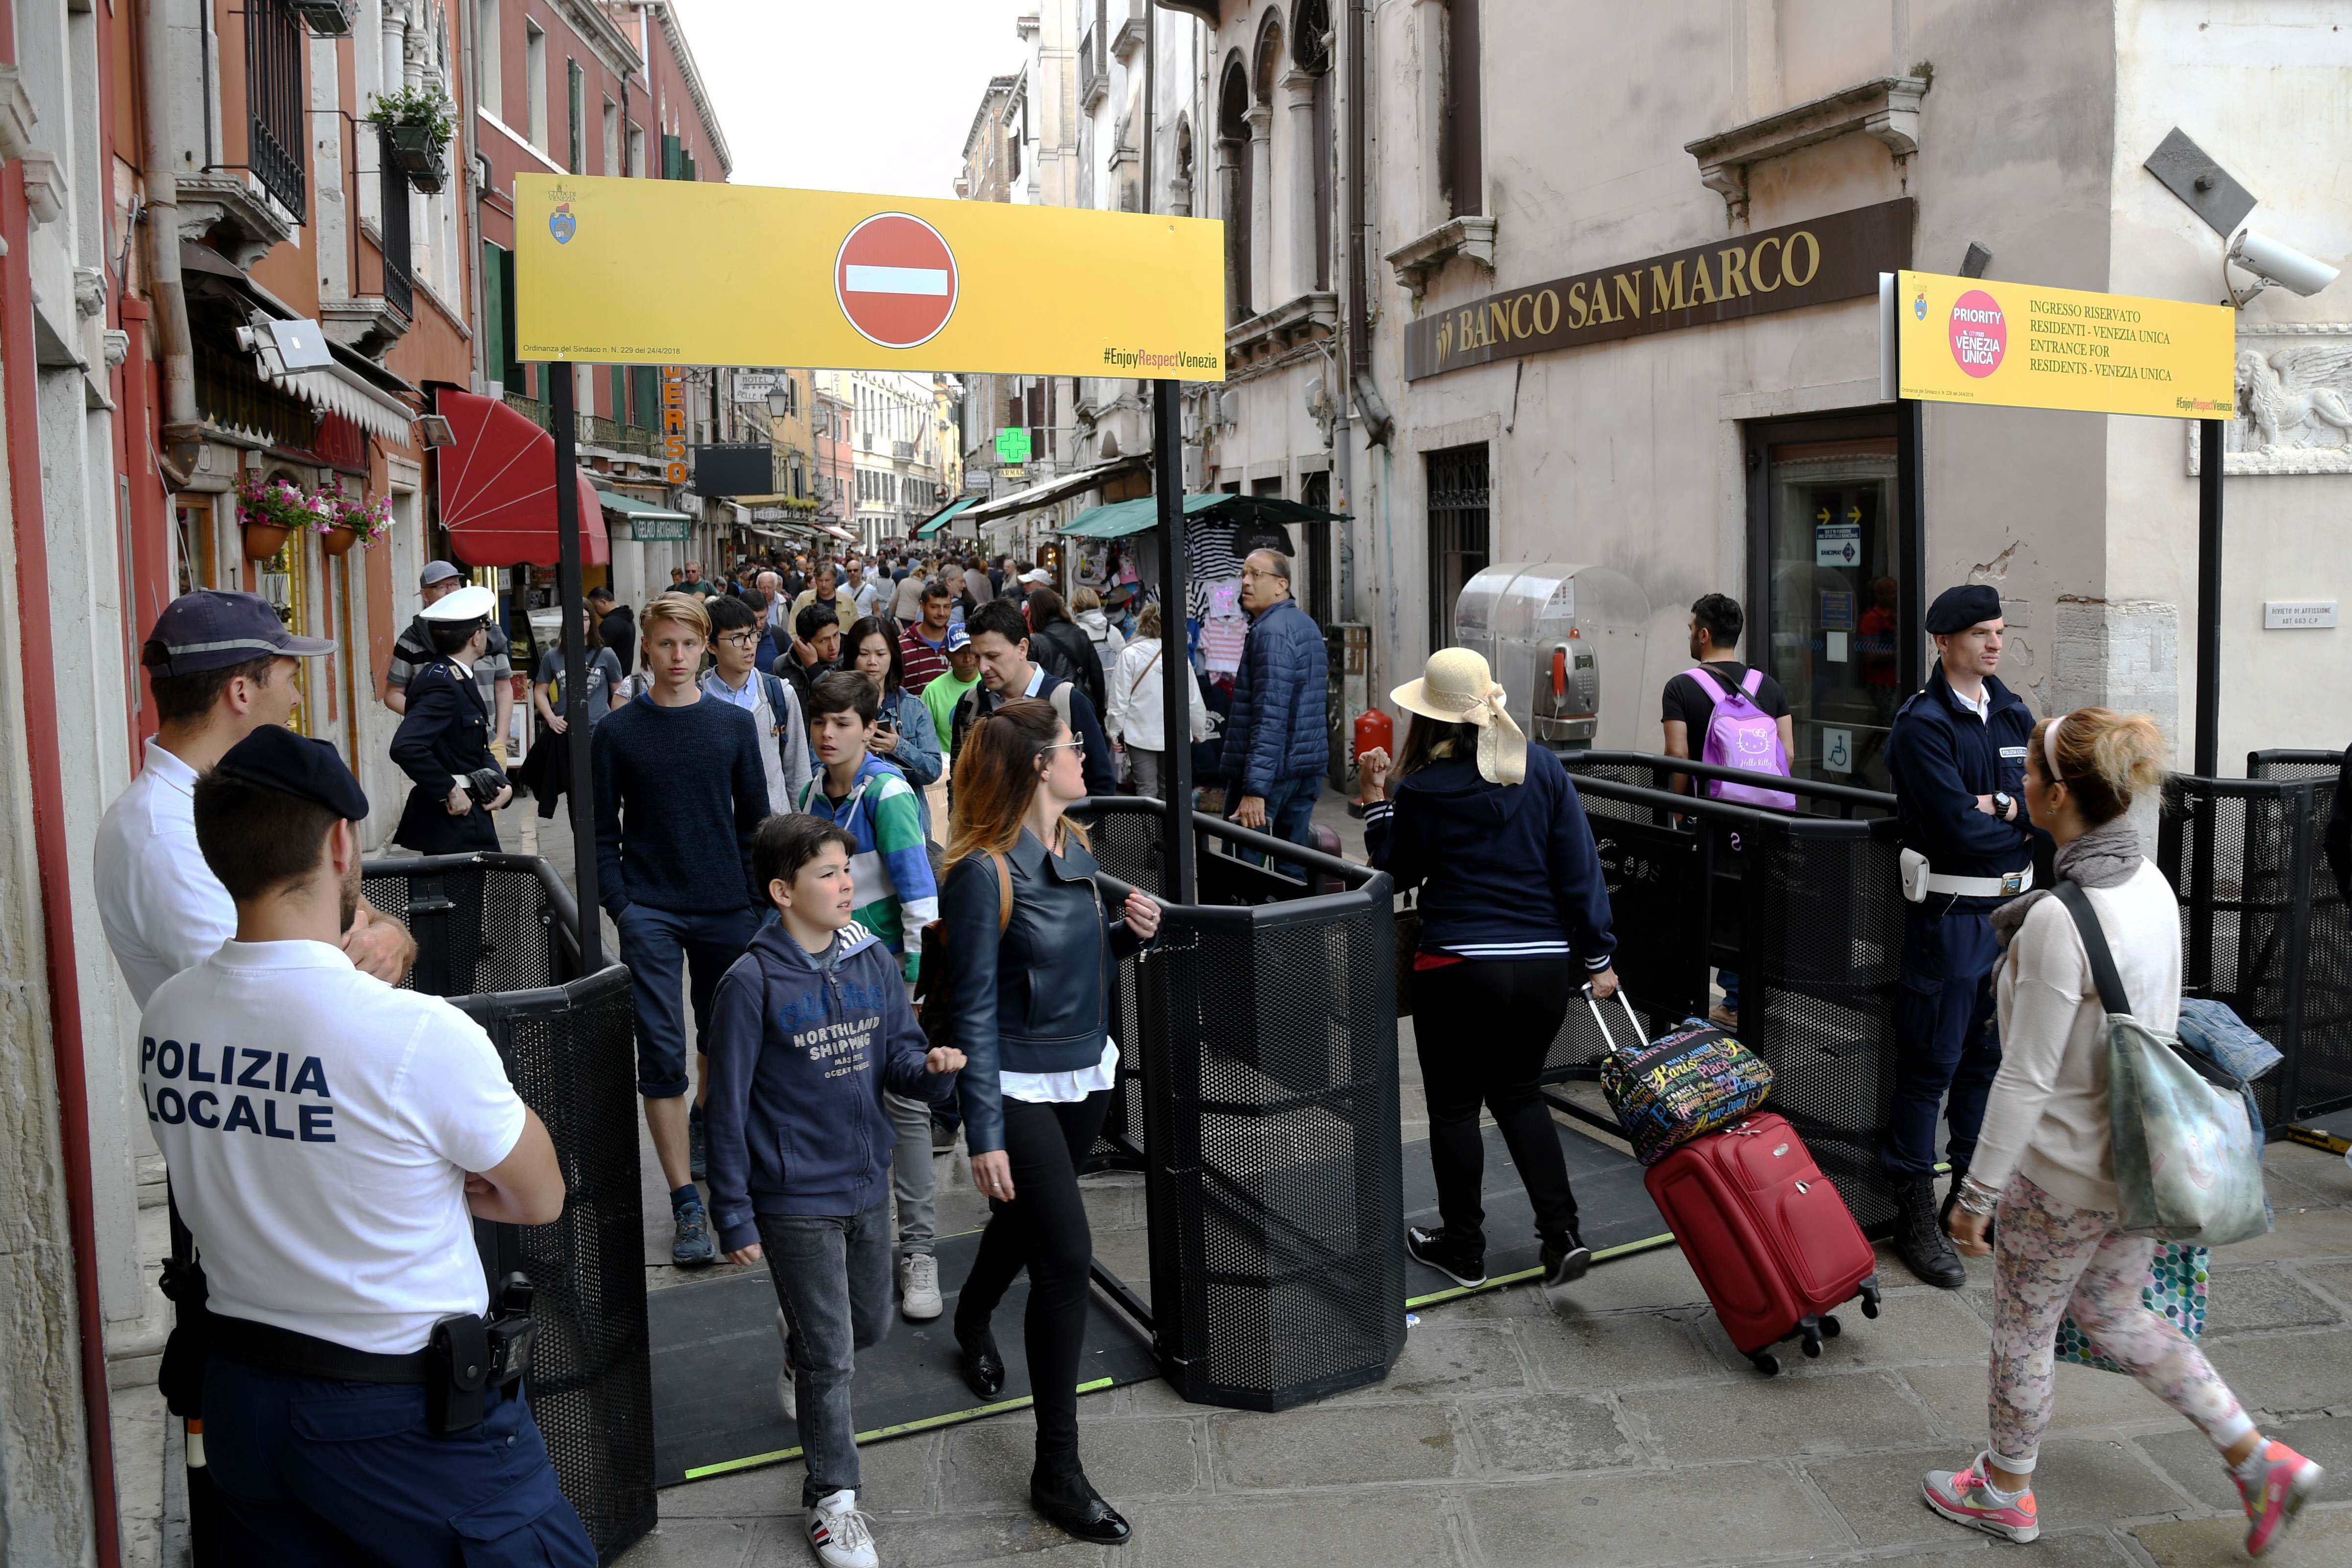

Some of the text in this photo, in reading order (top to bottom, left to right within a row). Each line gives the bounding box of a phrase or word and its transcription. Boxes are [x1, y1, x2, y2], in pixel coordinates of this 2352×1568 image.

[1458, 231, 1821, 353] BANCO SAN MARCO
[1953, 308, 2001, 325] PRIORITY
[2030, 300, 2140, 323] INGRESSO RISERVATO
[2030, 319, 2086, 336] RESIDENTI
[2093, 326, 2136, 341] VENEZIA
[2139, 330, 2170, 344] UNICA
[1103, 347, 1217, 370] #EnjoyRespectVenezia
[1962, 350, 1994, 365] UNICA
[2030, 339, 2110, 357] ENTRANCE FOR
[2030, 358, 2087, 375] RESIDENTS
[2094, 364, 2138, 379] VENEZIA
[2141, 368, 2172, 381] UNICA
[2176, 396, 2232, 412] #EnjoyRespectVenezia
[638, 520, 683, 538] GELATO ARTIGIANALE
[1739, 758, 1772, 769] Hello Kitty
[793, 1016, 880, 1047] NORTHLAND
[809, 1033, 871, 1061] SHIPPING
[142, 1036, 331, 1098] POLIZIA
[1696, 1059, 1731, 1078] Place
[1665, 1084, 1695, 1102] FRANCE
[1731, 1076, 1757, 1093] Paris
[143, 1081, 336, 1142] LOCALE
